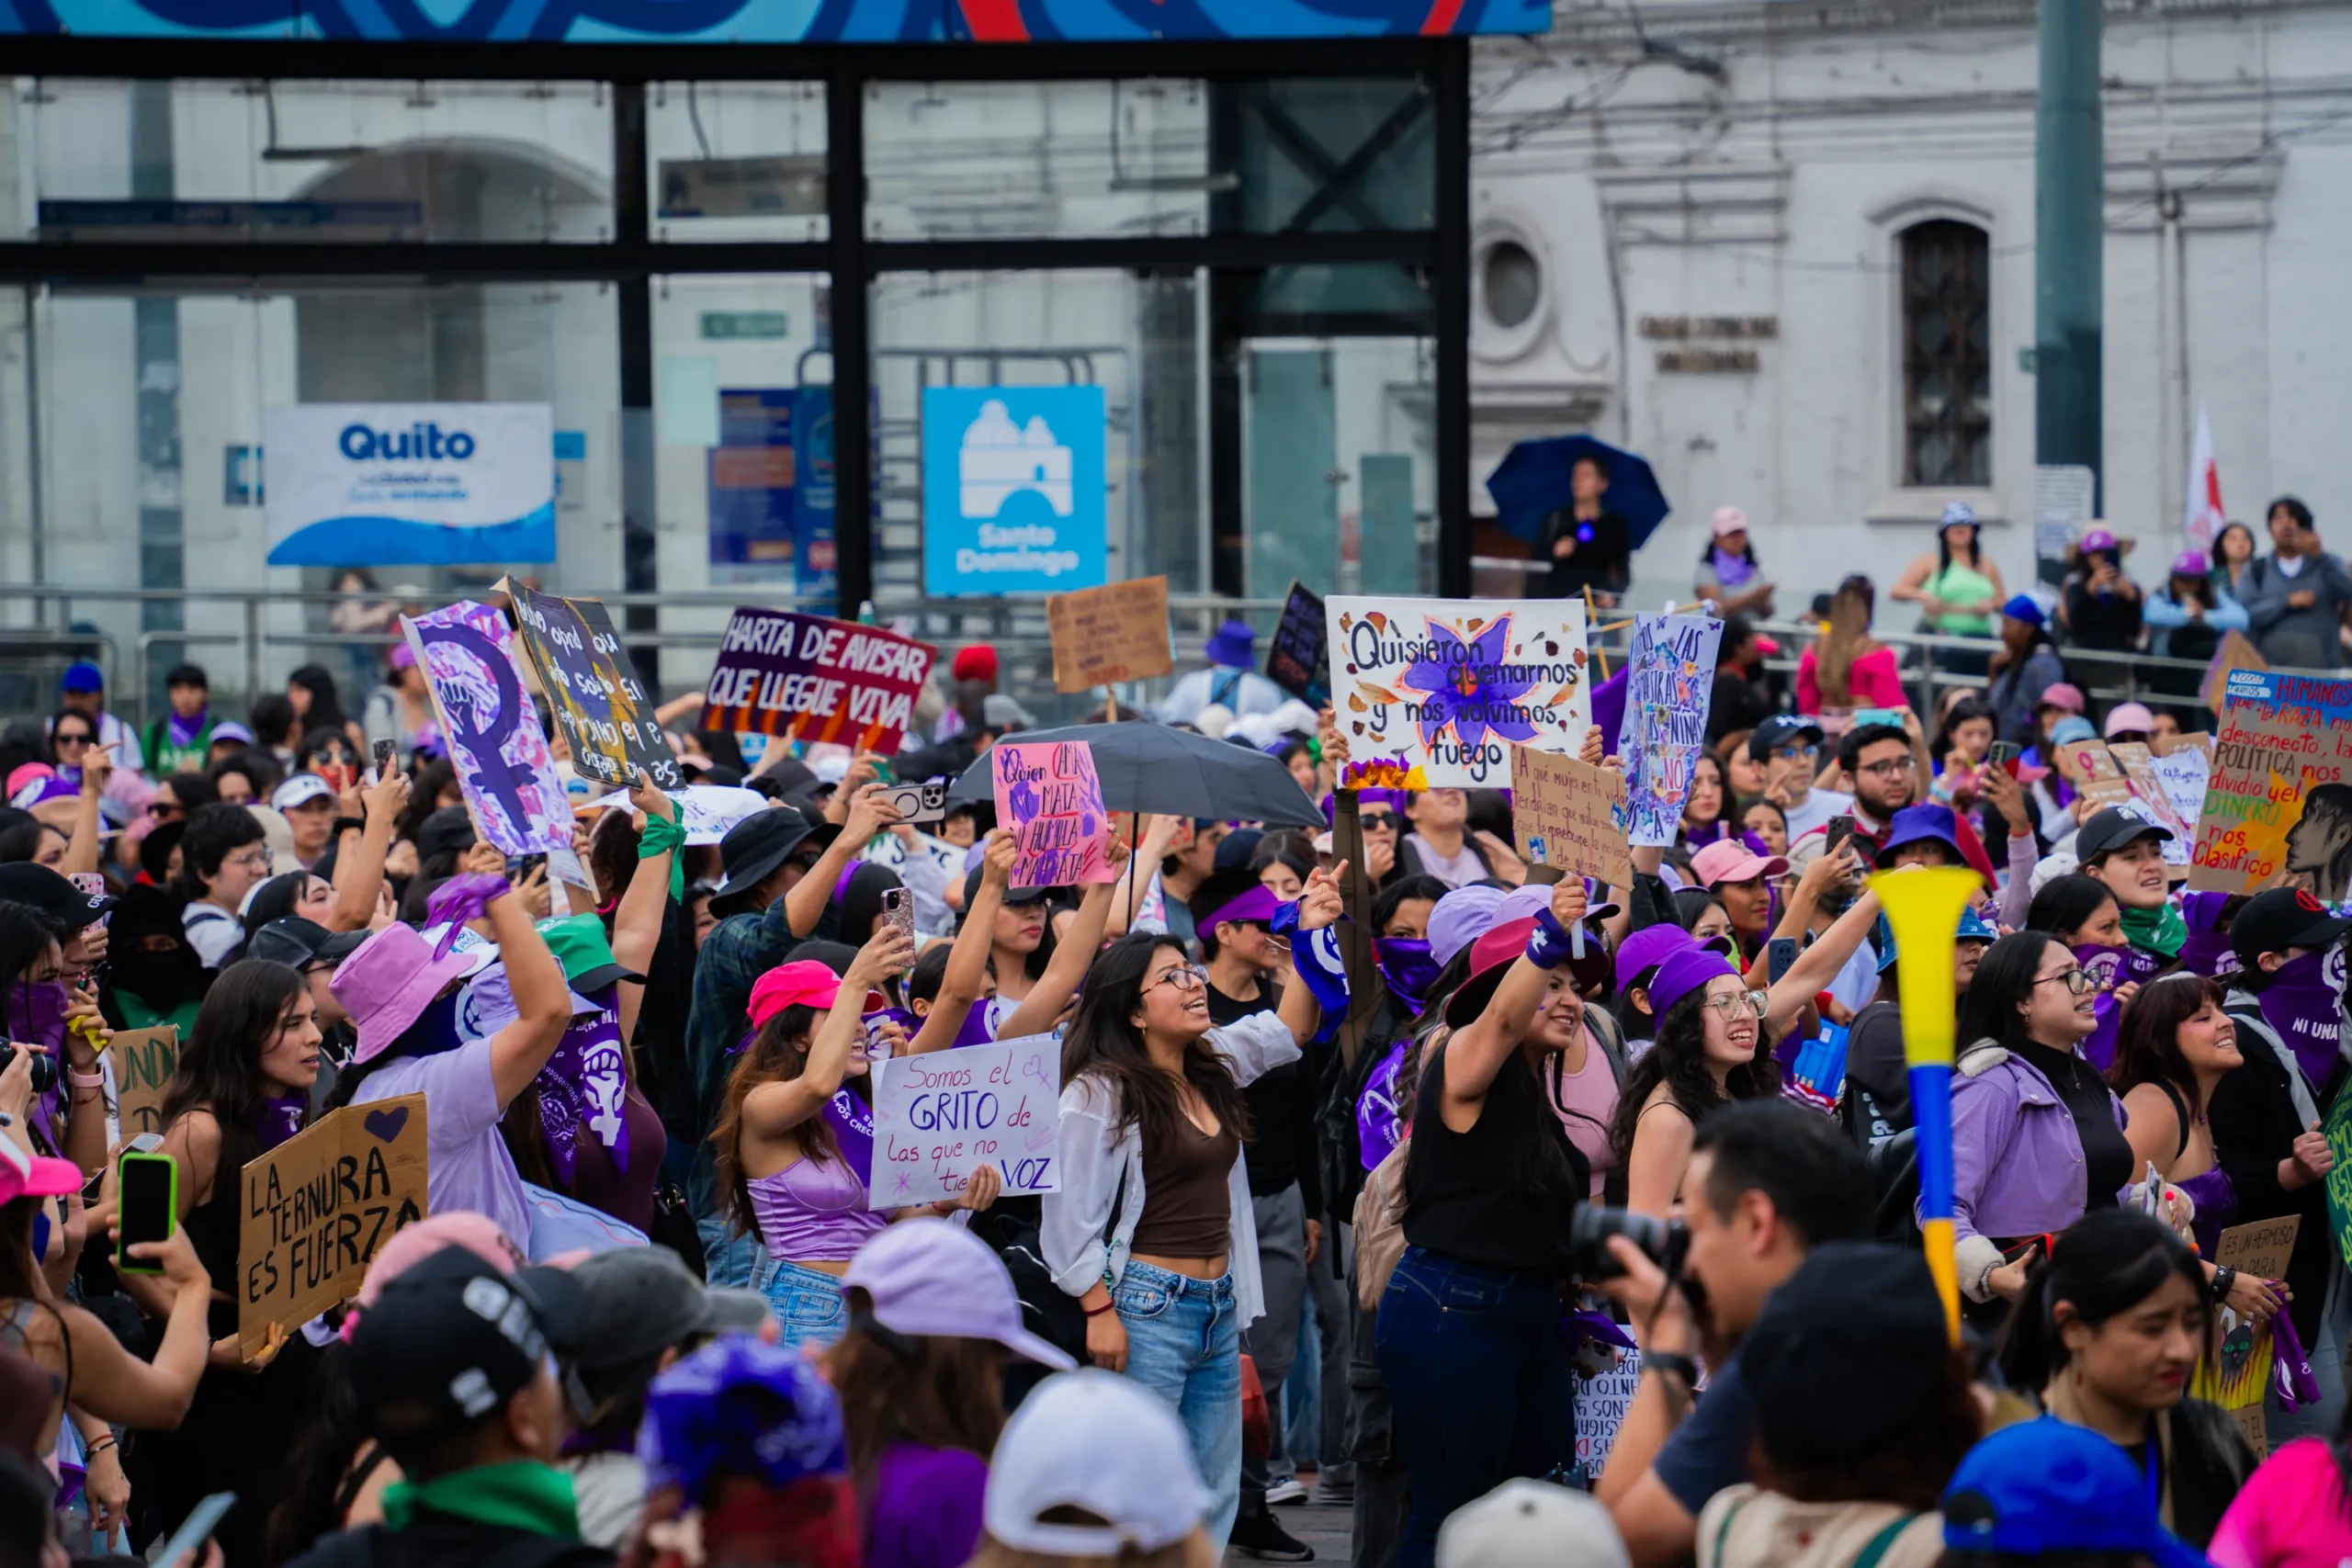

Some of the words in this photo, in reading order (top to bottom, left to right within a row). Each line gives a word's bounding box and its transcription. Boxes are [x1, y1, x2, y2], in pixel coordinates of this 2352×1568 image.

[340, 423, 474, 459] Quito
[978, 523, 1056, 548] Santo
[956, 548, 1080, 577] Domingo
[551, 625, 583, 658] pudo
[722, 615, 796, 658] HARTA
[799, 625, 846, 666] DE
[838, 634, 927, 683] AVISAR
[1351, 620, 1484, 671] Quisieron
[1675, 625, 1703, 662] LAS
[619, 678, 643, 701] 15
[1447, 662, 1577, 696] quemarnos
[2277, 675, 2352, 708] HUMANOS
[707, 666, 760, 706] QUE
[757, 671, 846, 716] LLEGUE
[849, 685, 912, 732] VIVA
[1370, 704, 1387, 733] y
[1406, 701, 1444, 722] nos
[1457, 694, 1557, 724] volvimos
[2226, 696, 2255, 717] que
[2277, 705, 2323, 729] RAZA
[1670, 709, 1702, 746] NIÑAS
[1003, 749, 1046, 784] Quien
[1430, 726, 1503, 783] fuego
[1664, 758, 1684, 790] NO
[2301, 763, 2340, 781] nos
[1010, 789, 1036, 820] NO
[1042, 783, 1079, 816] MATA
[1606, 779, 1625, 804] vida
[2204, 791, 2280, 826] DINERO
[1654, 809, 1665, 840] A
[2209, 825, 2246, 846] nos
[1556, 845, 1570, 865] de
[2292, 1017, 2308, 1034] NI
[2312, 1021, 2339, 1041] UNA
[903, 1056, 971, 1089] Somos
[989, 1048, 1012, 1085] el
[910, 1089, 999, 1132] GRITO
[1007, 1095, 1031, 1127] de
[931, 1142, 963, 1173] que
[974, 1140, 998, 1156] no
[251, 1162, 282, 1220] LA
[939, 1168, 967, 1192] tie
[1001, 1157, 1054, 1190] VOZ
[268, 1145, 391, 1247] TERNURA
[2224, 1235, 2239, 1256] ES
[2252, 1225, 2294, 1249] HERMOSO
[248, 1250, 278, 1304] ES
[2248, 1257, 2277, 1276] PARA
[2251, 1416, 2263, 1439] EL
